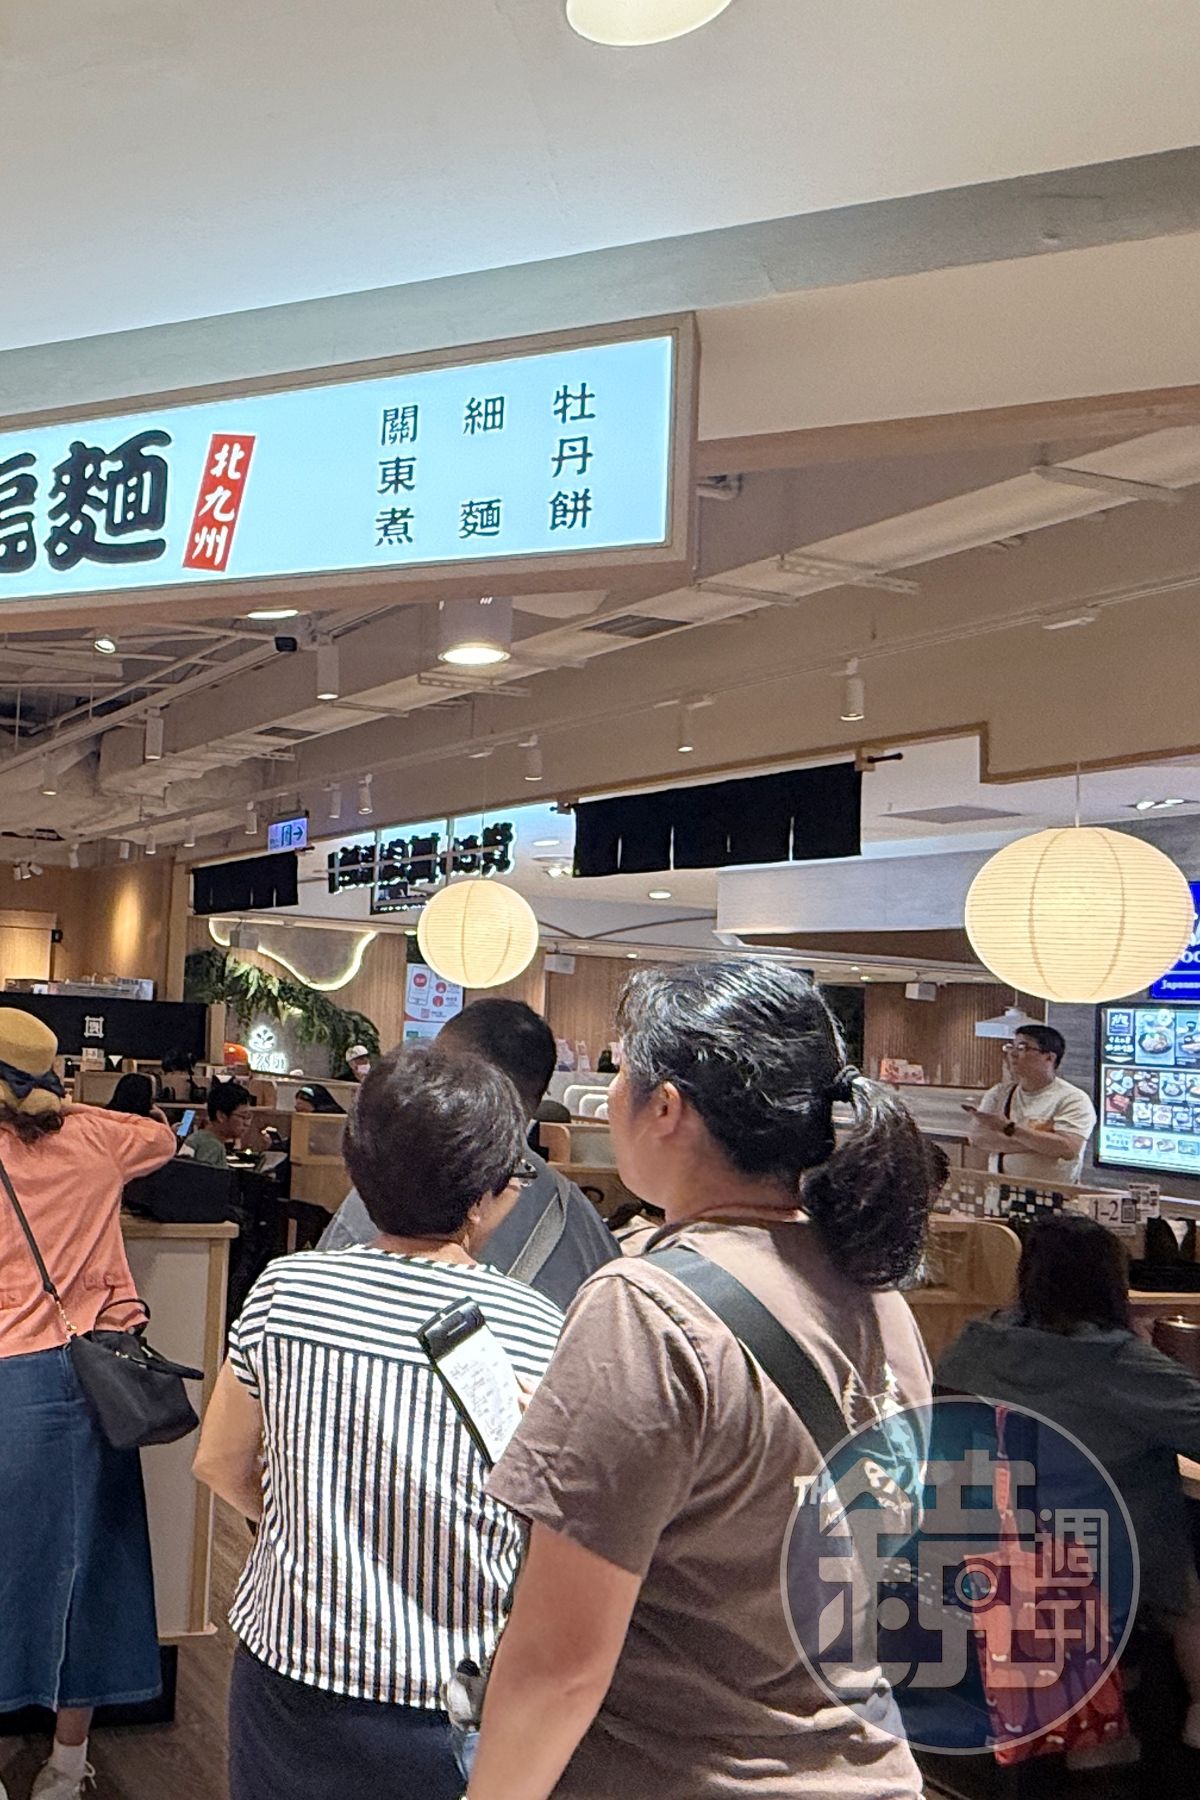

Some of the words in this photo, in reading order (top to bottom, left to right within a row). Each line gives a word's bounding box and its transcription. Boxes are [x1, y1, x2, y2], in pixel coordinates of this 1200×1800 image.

[191, 442, 246, 567] 北九州
[375, 404, 419, 547] 關東煮
[459, 396, 505, 539] 細麵
[549, 382, 596, 531] 牡丹餅
